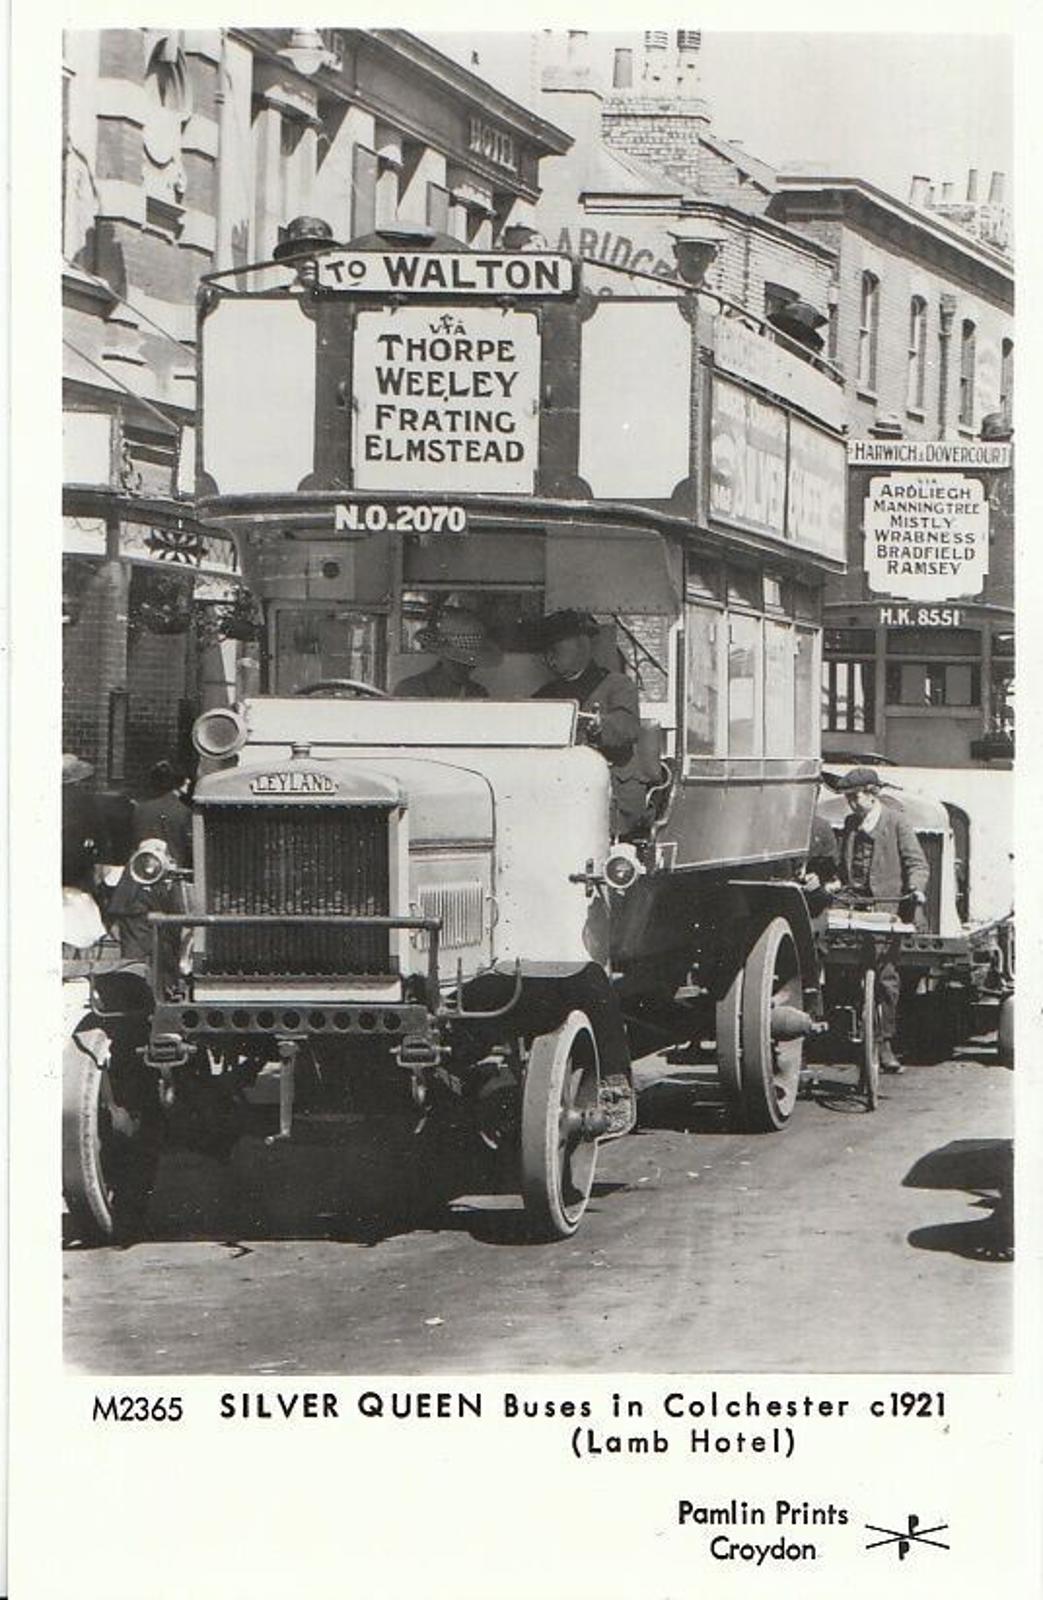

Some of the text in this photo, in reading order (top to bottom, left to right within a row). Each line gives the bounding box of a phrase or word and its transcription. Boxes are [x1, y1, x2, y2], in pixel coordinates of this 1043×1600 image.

[469, 116, 518, 173] HOTEL
[325, 255, 560, 289] TO WALTON
[377, 334, 516, 363] THORPE
[375, 367, 519, 398] WEELEY
[375, 404, 516, 433] FRATING
[364, 435, 525, 464] ELMSTEAD
[854, 442, 917, 462] HARWICH
[925, 443, 1008, 465] DOVERCOURT
[890, 514, 956, 529] MISTLY
[874, 529, 976, 544] WRABNESS
[877, 544, 976, 560] BRADFIELD
[887, 560, 961, 575] RAMSEY
[256, 772, 334, 791] LEYLAND
